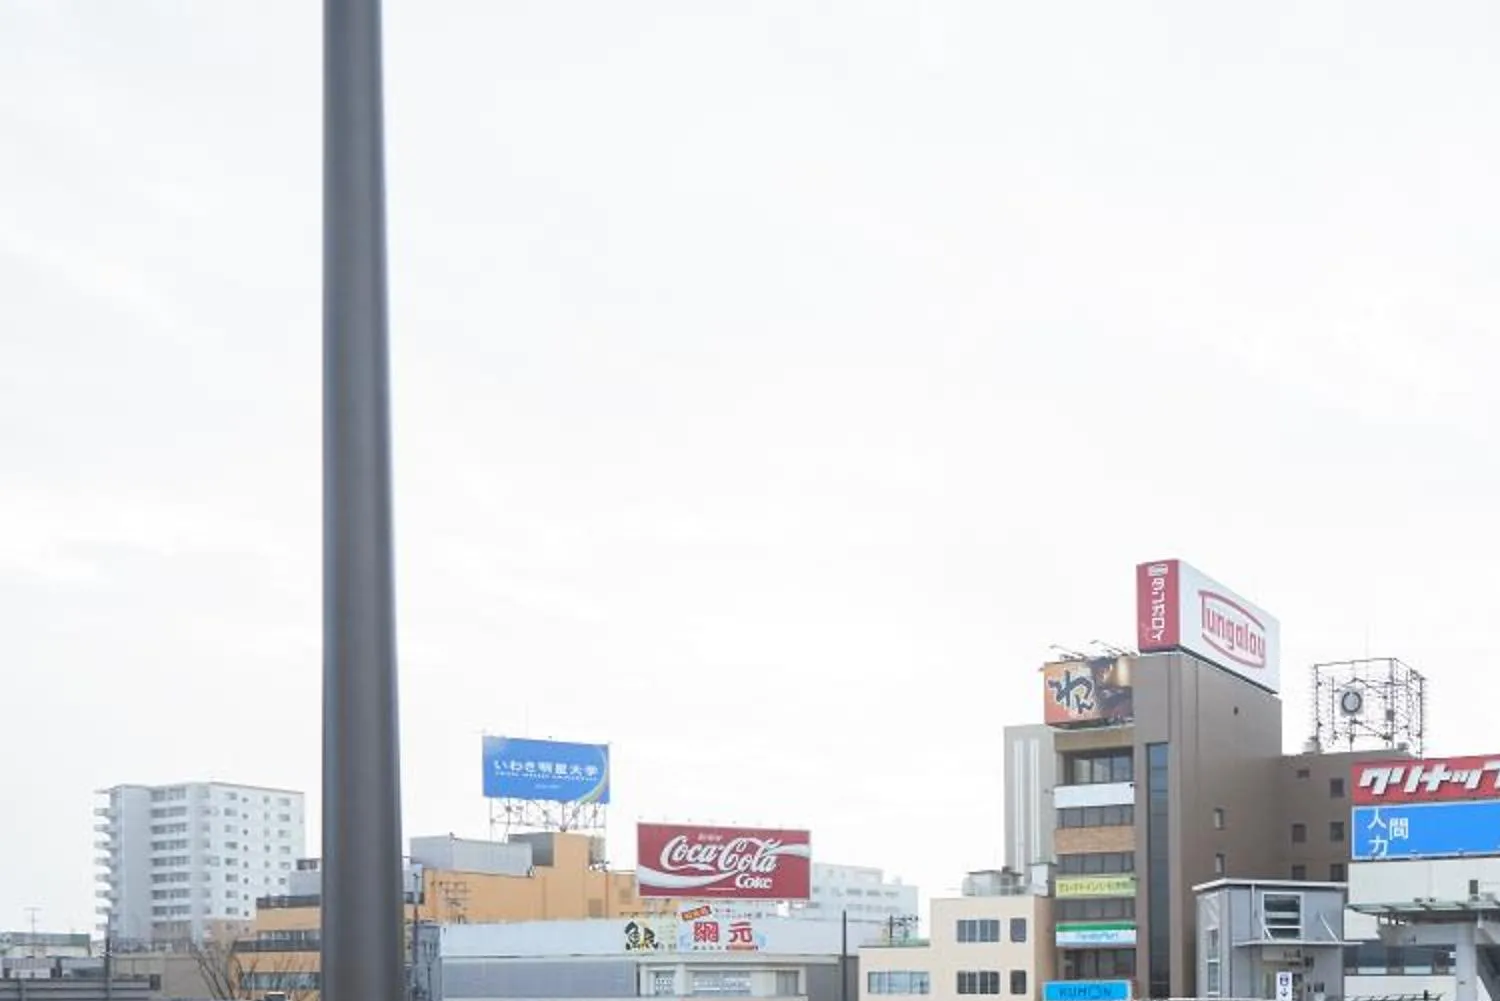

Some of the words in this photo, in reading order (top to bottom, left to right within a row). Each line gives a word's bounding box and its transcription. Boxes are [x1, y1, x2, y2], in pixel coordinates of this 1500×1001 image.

[1150, 578, 1167, 641] タンガロイ
[660, 835, 782, 873] Coca-Cola
[736, 873, 773, 889] Coke
